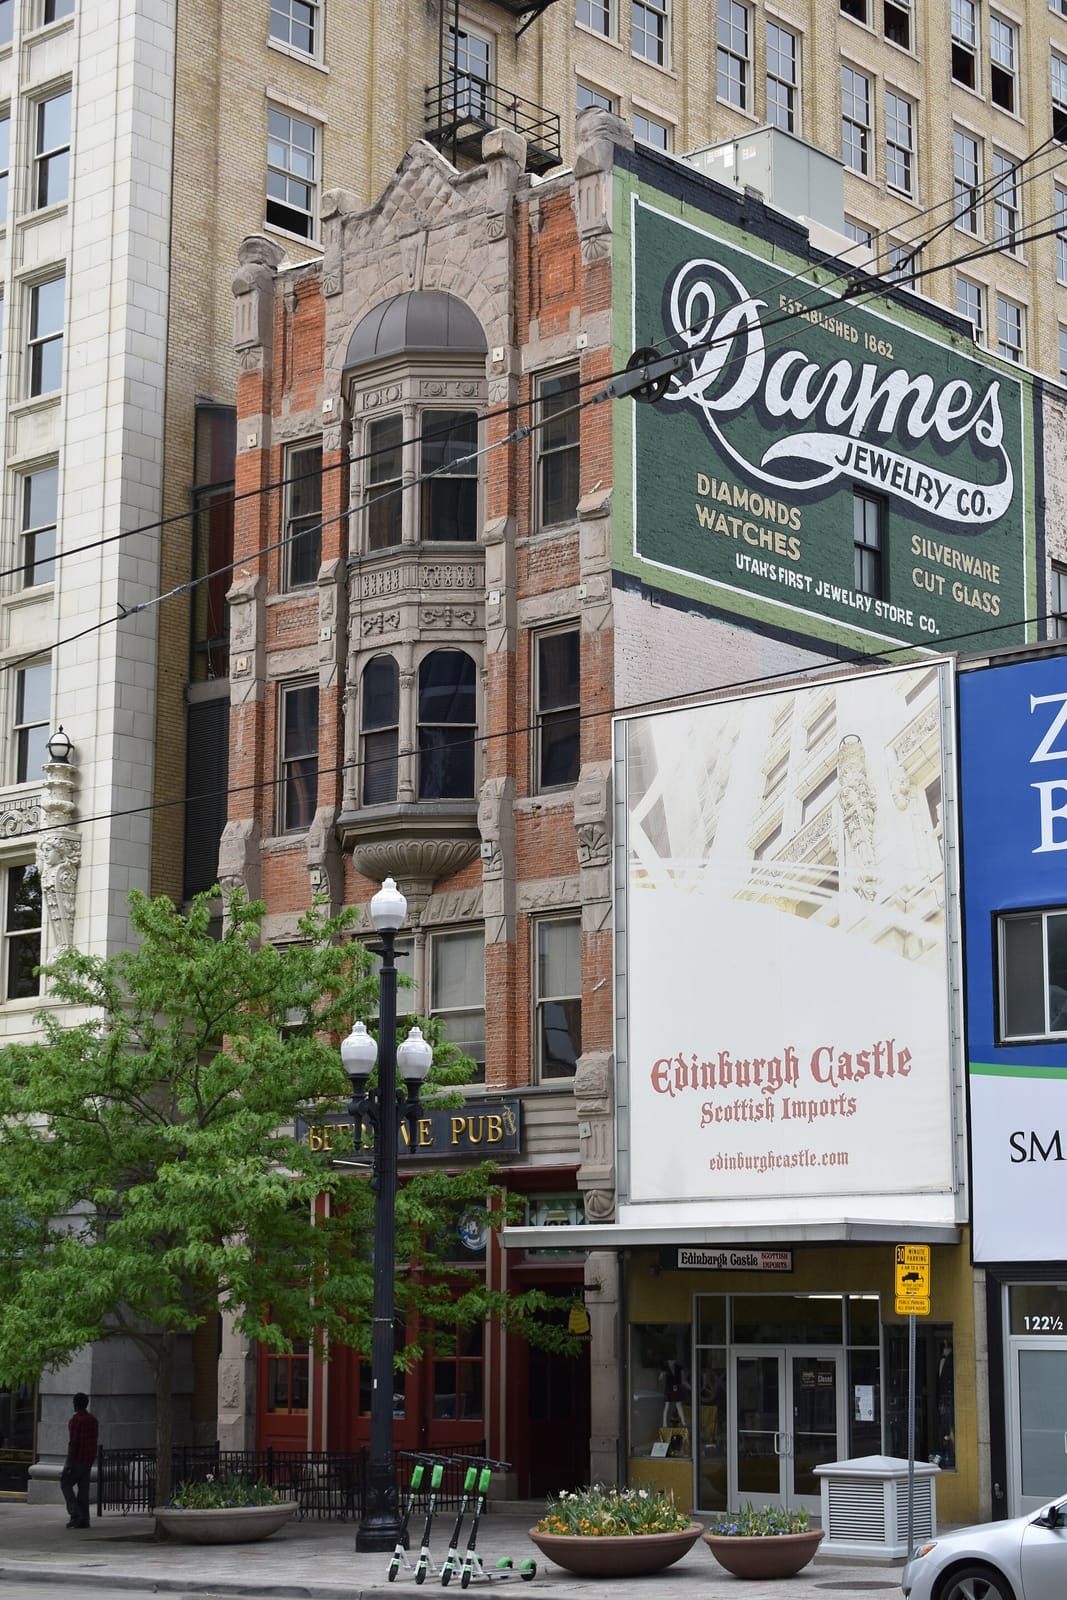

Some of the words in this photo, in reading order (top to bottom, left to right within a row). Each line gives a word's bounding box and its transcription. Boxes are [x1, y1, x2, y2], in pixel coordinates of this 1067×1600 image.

[780, 294, 859, 344] ESTABLISHED
[864, 332, 894, 360] 1862
[696, 473, 802, 532] DIAMONDS
[834, 442, 952, 510] JEWELRY
[956, 488, 992, 516] CO.
[695, 503, 802, 561] WATCHES
[911, 534, 1000, 585] SILVERWARE
[735, 553, 777, 581] UTAH'S
[778, 567, 813, 592] FIRST
[815, 580, 872, 613] JEWELRY
[874, 601, 914, 627] STORE
[919, 615, 940, 635] CO.
[912, 567, 946, 596] CUT
[951, 581, 1000, 616] GLASS
[650, 1045, 800, 1098] Edinburgh
[810, 1038, 912, 1088] Castle
[450, 1115, 503, 1144] PUB
[700, 1096, 775, 1129] Scottish
[780, 1092, 857, 1124] Imports
[709, 1149, 849, 1173] edinburghcastle.com
